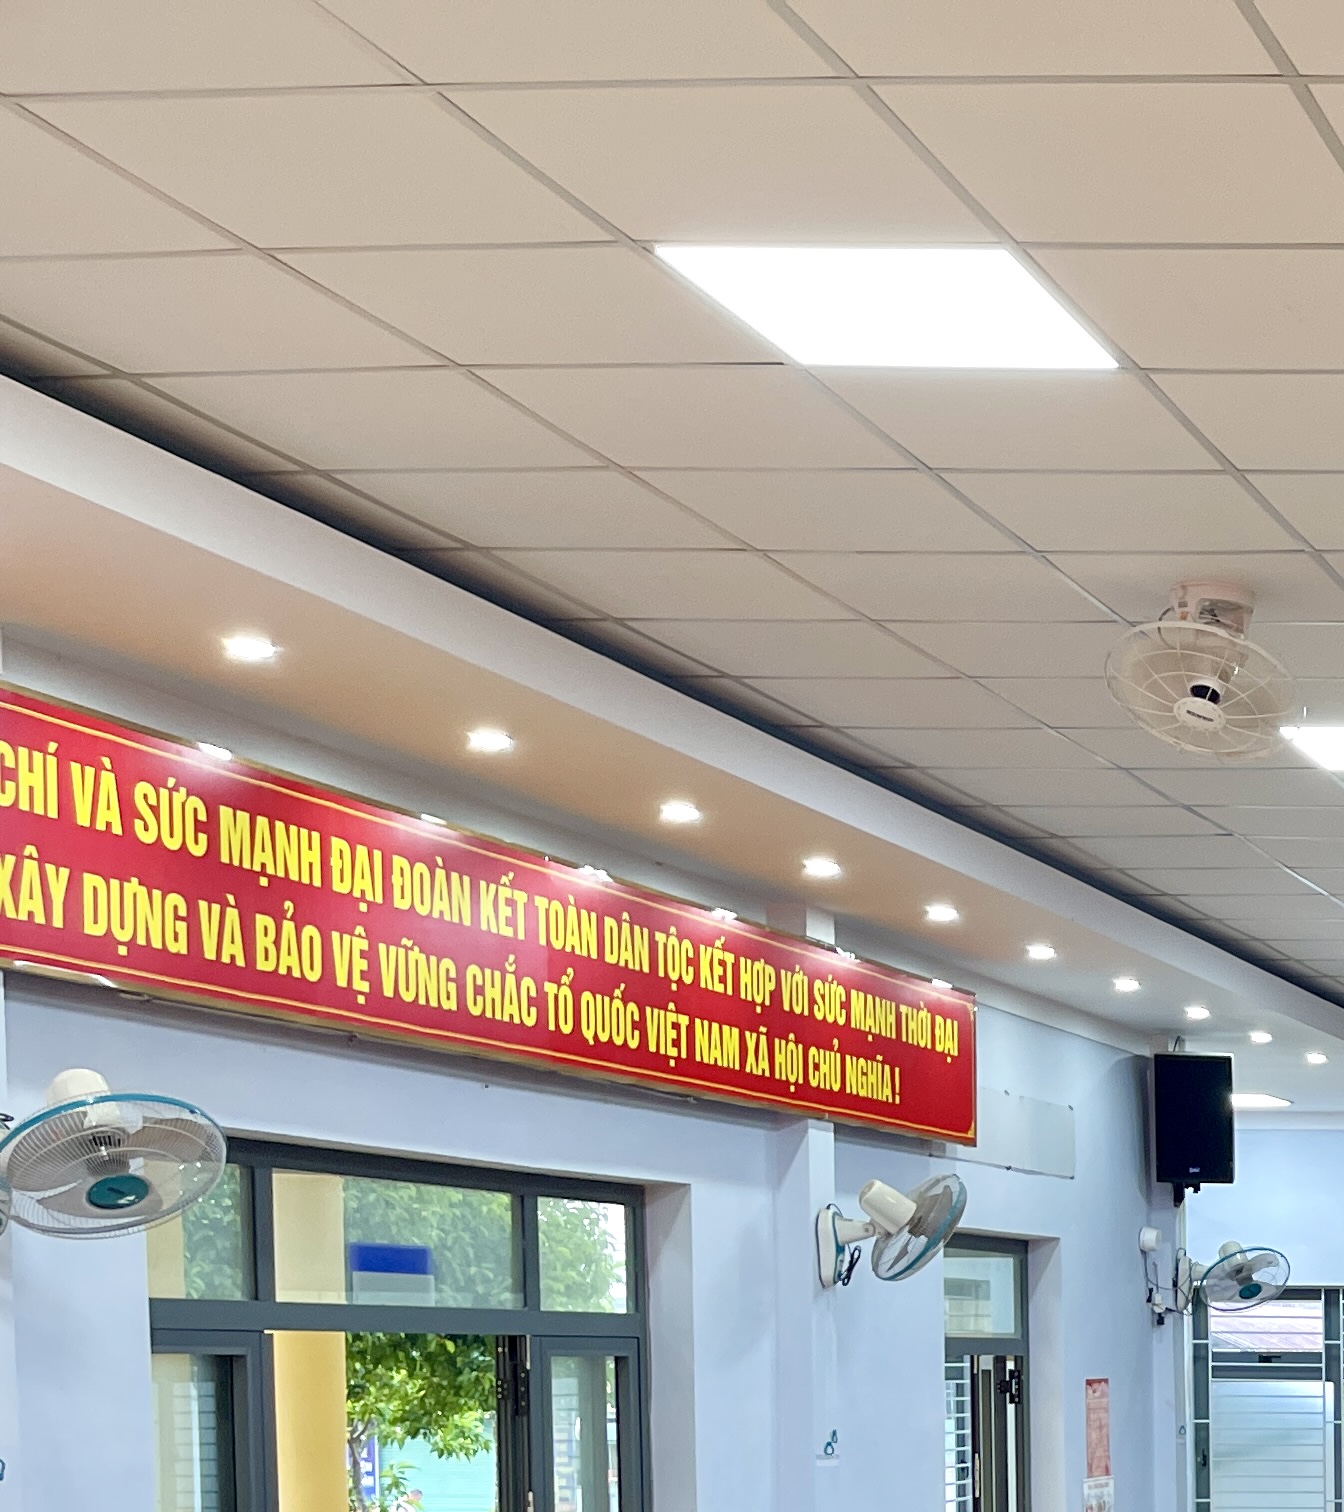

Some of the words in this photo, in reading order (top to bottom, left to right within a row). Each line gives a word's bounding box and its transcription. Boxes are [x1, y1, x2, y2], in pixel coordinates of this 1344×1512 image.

[0, 740, 58, 819] CHÍ
[70, 756, 123, 836] VÀ
[134, 776, 208, 857] SỨC
[219, 805, 322, 887] MẠNH
[330, 836, 384, 913] ĐẠI
[391, 854, 471, 927] ĐOÀN
[479, 871, 528, 941] KẾT
[534, 894, 598, 960] TOÀN
[603, 911, 650, 974] DÂN
[654, 925, 695, 992] TỘC
[699, 936, 735, 996] KẾT
[739, 956, 776, 1014] HỢP
[780, 964, 809, 1016] VỚI
[813, 974, 846, 1026] SỨC
[850, 988, 897, 1042] MẠNH
[899, 1000, 932, 1050] THỜI
[935, 1014, 959, 1064] ĐẠI
[0, 844, 70, 929] XÂY
[83, 872, 188, 957] DỰNG
[198, 893, 246, 968] VÀ
[255, 900, 322, 983] BẢO
[331, 925, 370, 1005] VỆ
[378, 937, 457, 1011] VỮNG
[466, 954, 537, 1027] CHẮC
[544, 967, 574, 1035] TỔ
[580, 983, 640, 1049] QUỐC
[645, 1002, 690, 1067] VIỆT
[694, 1018, 740, 1071] NAM
[745, 1025, 770, 1078] XÃ
[774, 1032, 804, 1093] HỘI
[808, 1038, 841, 1092] CHỦ
